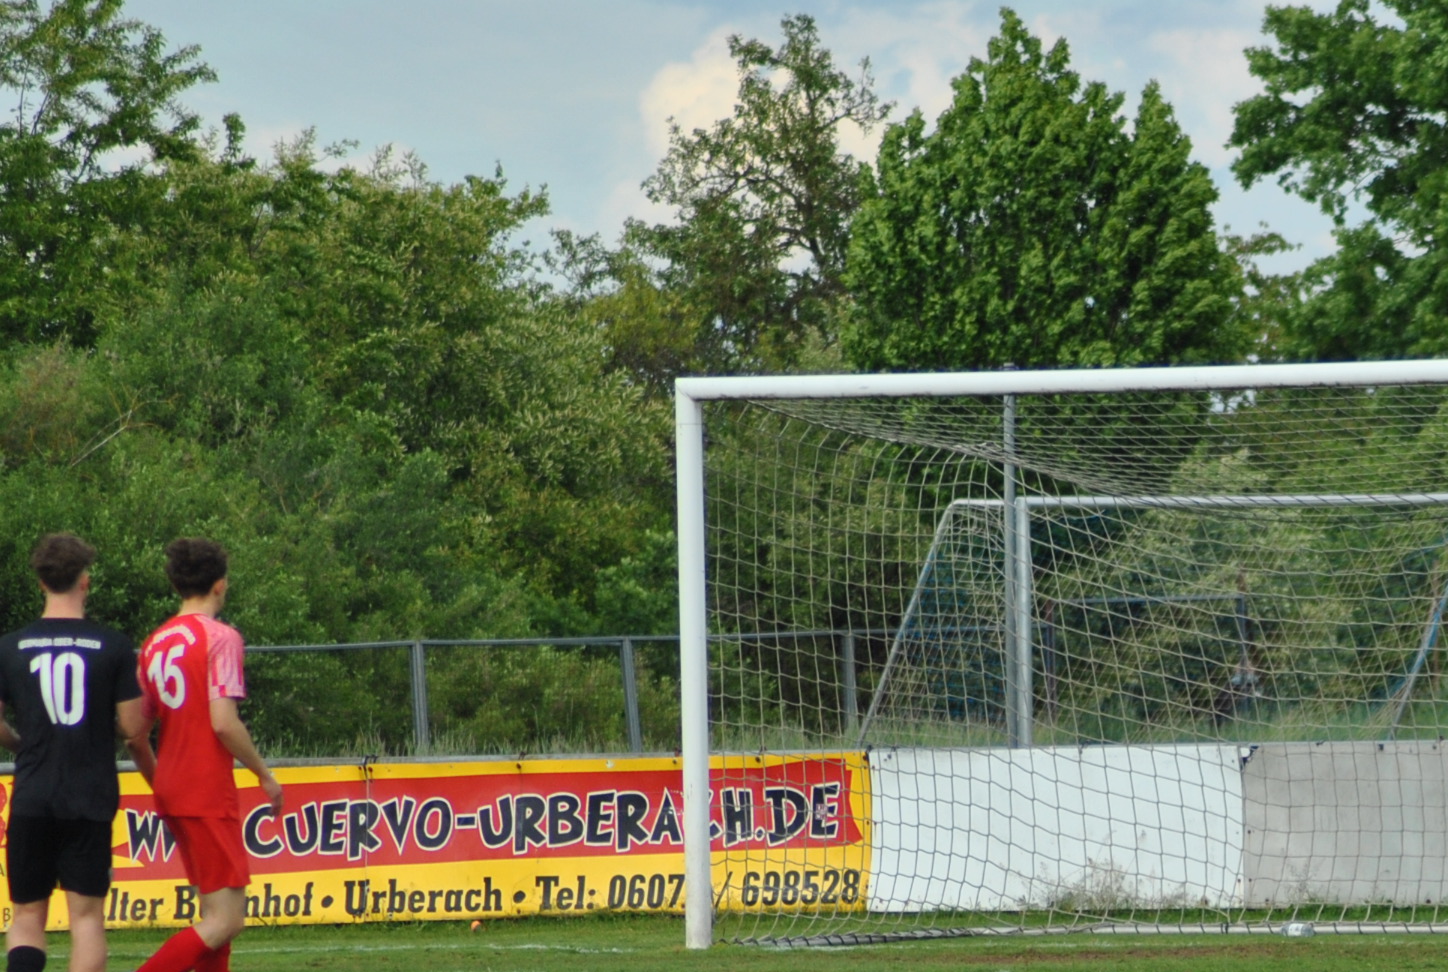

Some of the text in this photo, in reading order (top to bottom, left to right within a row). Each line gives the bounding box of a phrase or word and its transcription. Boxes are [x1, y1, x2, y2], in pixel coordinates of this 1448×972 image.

[30, 652, 85, 725] 10
[104, 887, 164, 922] lter
[173, 881, 314, 920] Bnhof
[343, 877, 503, 916] Urberach
[535, 875, 597, 912] Tel:
[608, 872, 687, 910] 0607
[741, 869, 861, 907] 698528
